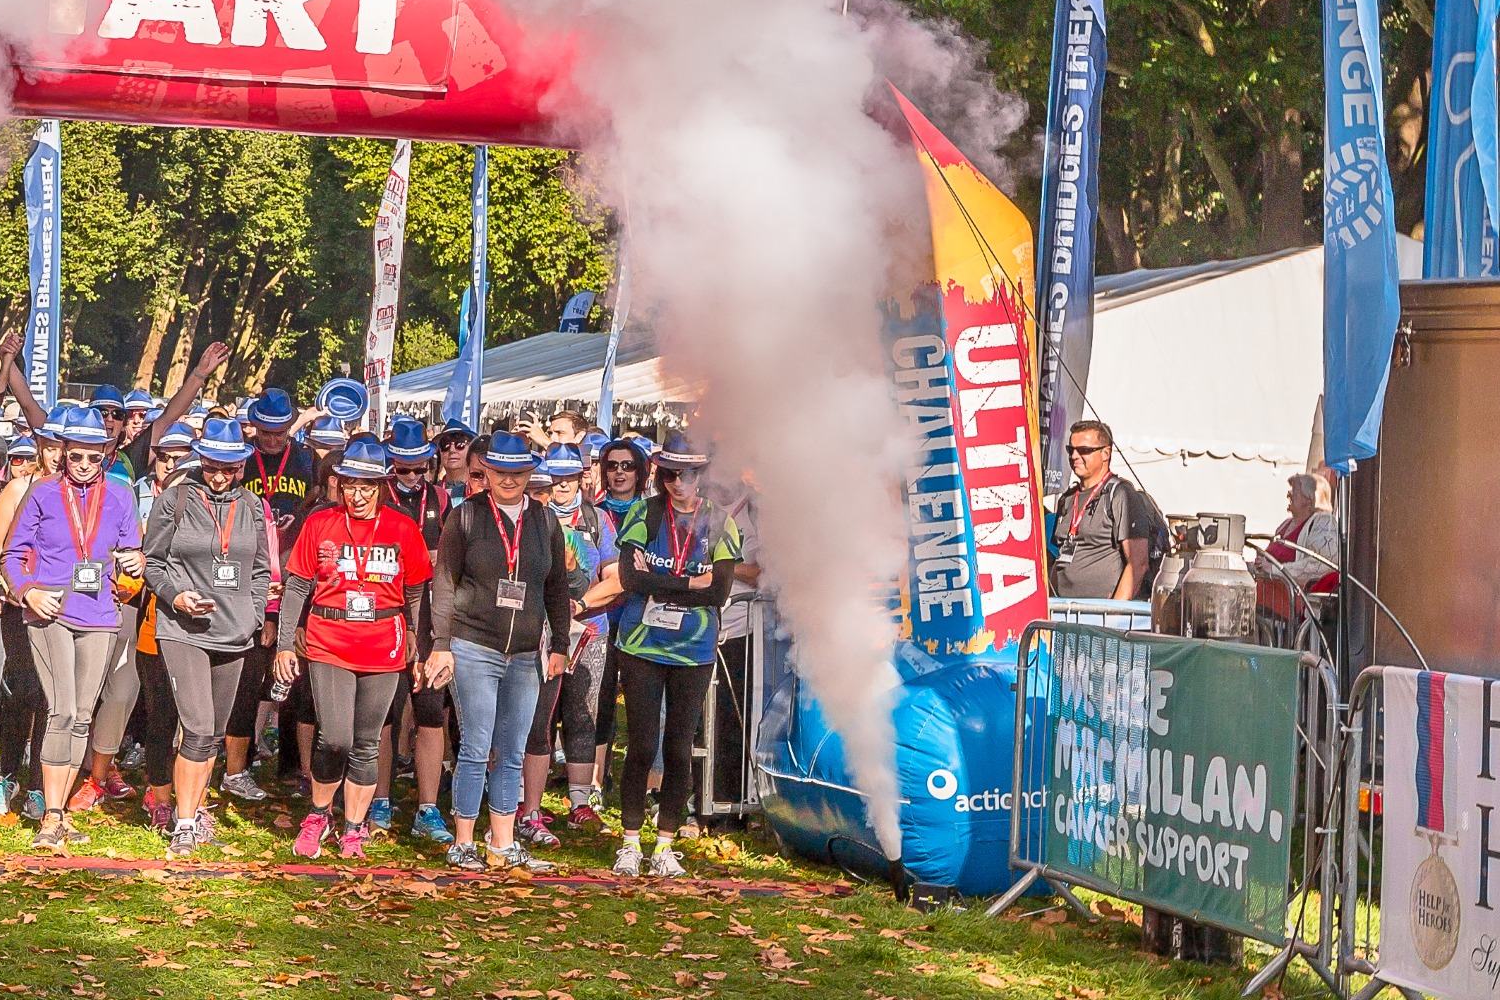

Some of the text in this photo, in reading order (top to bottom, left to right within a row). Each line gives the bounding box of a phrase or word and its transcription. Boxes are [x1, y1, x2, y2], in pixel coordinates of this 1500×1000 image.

[1051, 108, 1085, 275] BRIDGES
[892, 334, 974, 623] CHALLENGE
[954, 324, 1039, 619] ULTRA
[644, 549, 675, 569] nited
[1101, 662, 1174, 736] ARE
[1054, 716, 1283, 843] MACMILLAN.
[1054, 793, 1249, 891] CANCER SUPPORT
[1418, 908, 1451, 933] HEROES
[1419, 889, 1441, 911] HELP
